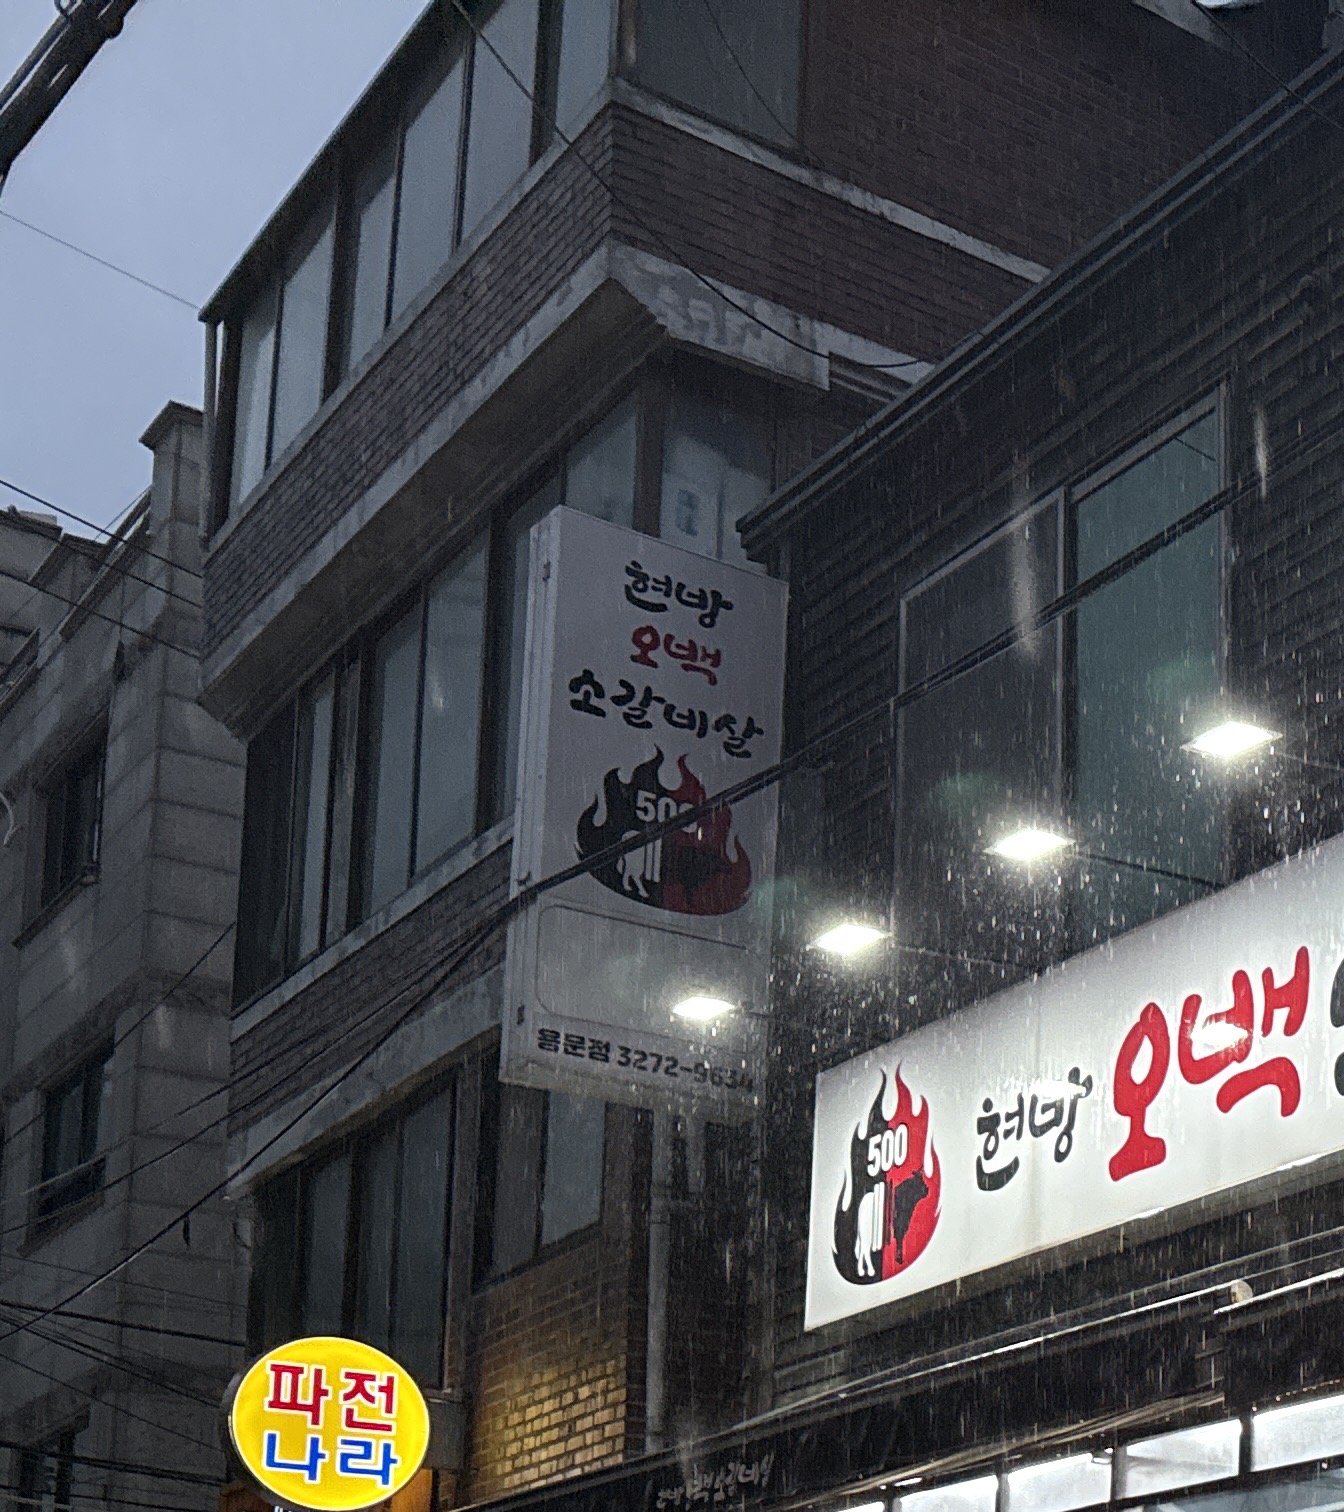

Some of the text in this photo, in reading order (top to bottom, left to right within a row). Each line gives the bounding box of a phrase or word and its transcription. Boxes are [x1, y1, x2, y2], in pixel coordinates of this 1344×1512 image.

[624, 559, 734, 628] 현방
[630, 624, 722, 687] 오백
[567, 668, 765, 760] 소갈비살
[537, 1027, 611, 1064] 용문점
[866, 1123, 909, 1176] 500
[975, 1066, 1094, 1192] 현방
[265, 1361, 400, 1434] 파전
[264, 1431, 400, 1487] 나라
